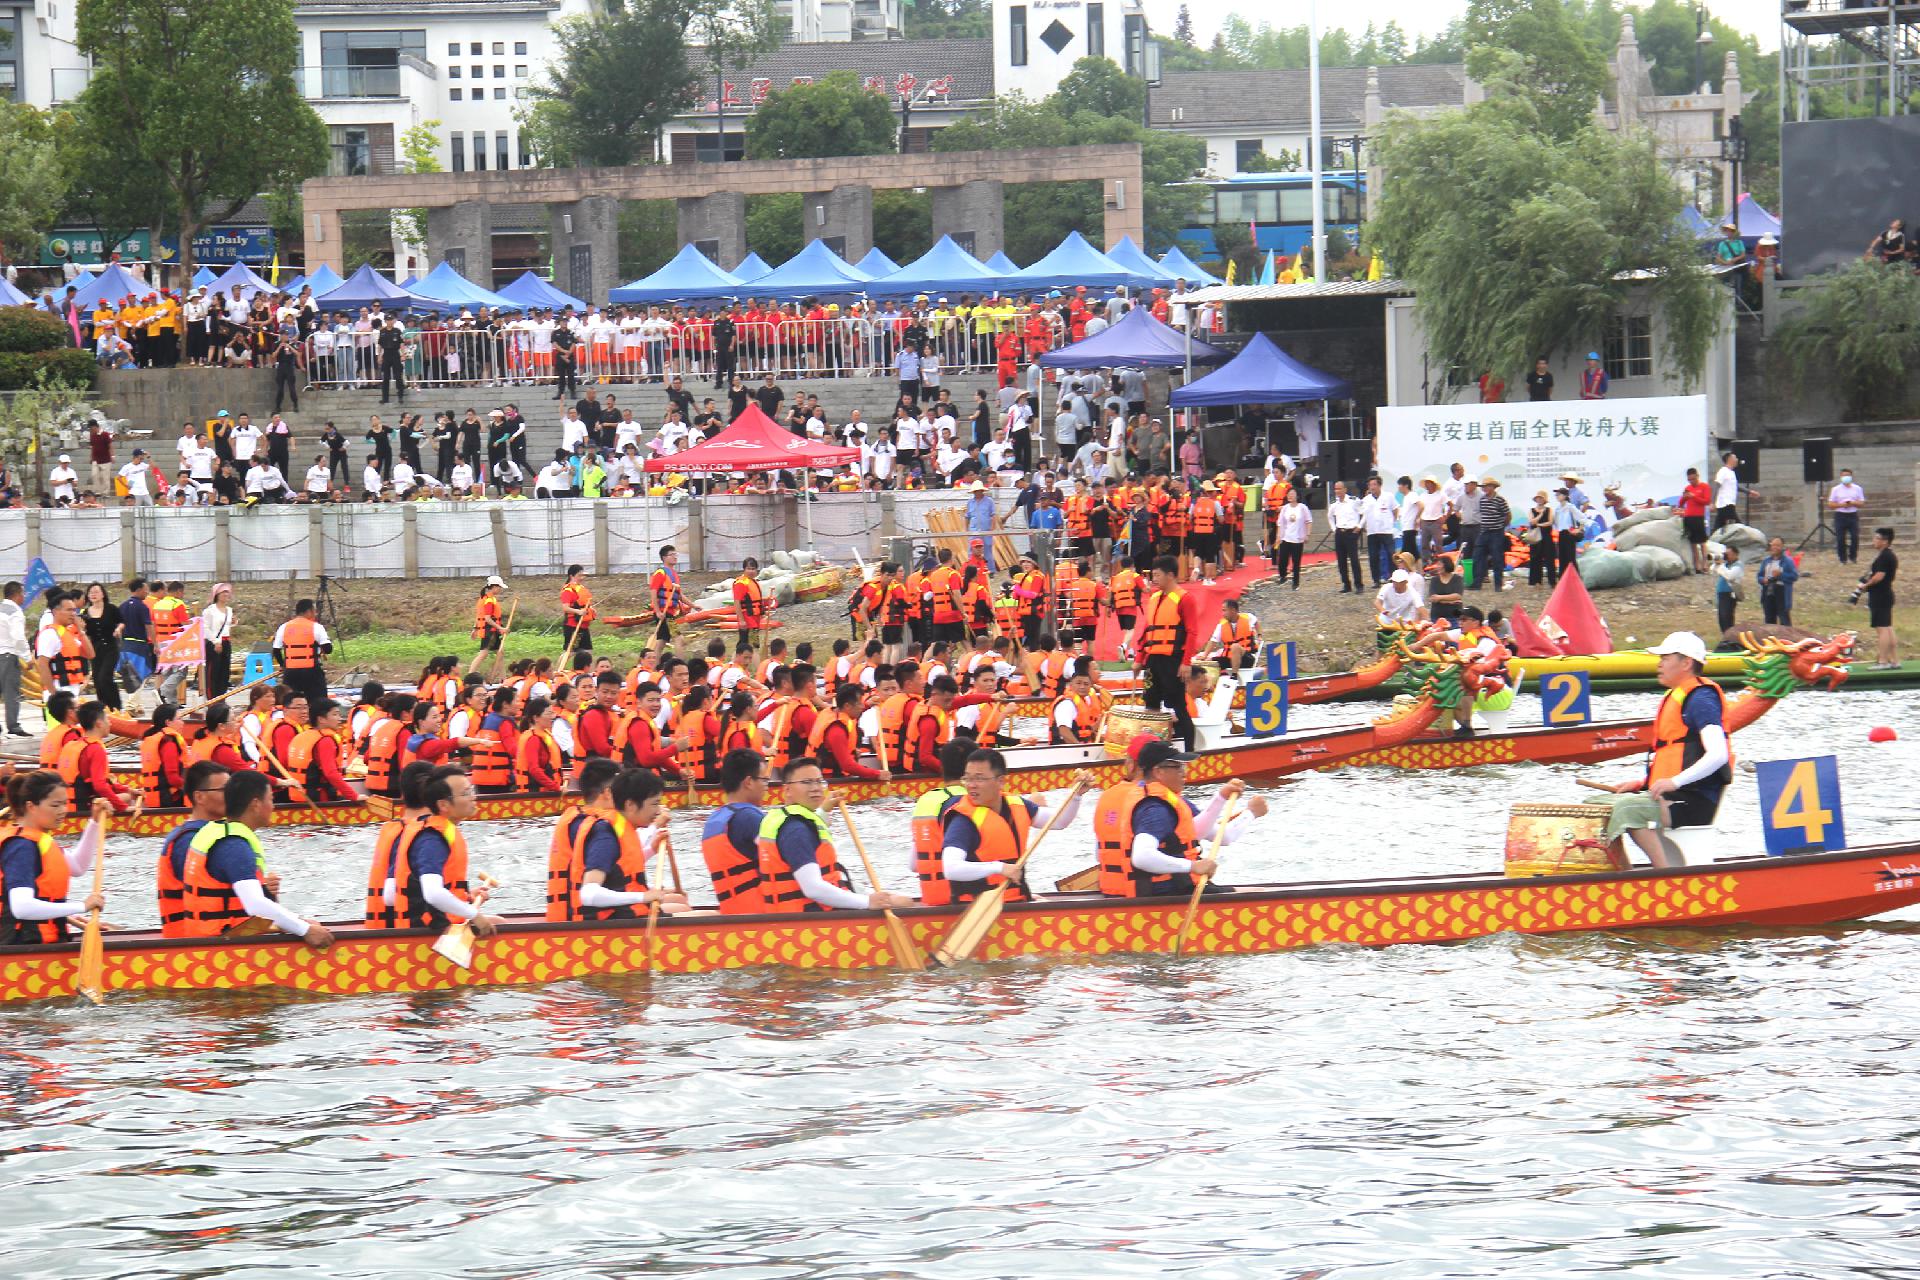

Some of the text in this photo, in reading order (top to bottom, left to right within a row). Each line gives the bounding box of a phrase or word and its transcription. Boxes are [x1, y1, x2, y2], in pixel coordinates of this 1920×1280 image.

[215, 235, 249, 246] Daily
[1423, 415, 1660, 442] 淳安县首届全民龙舟大赛
[1273, 643, 1289, 676] 1
[1251, 681, 1282, 732] 3
[1548, 674, 1585, 722] 2
[1772, 760, 1833, 843] 4
